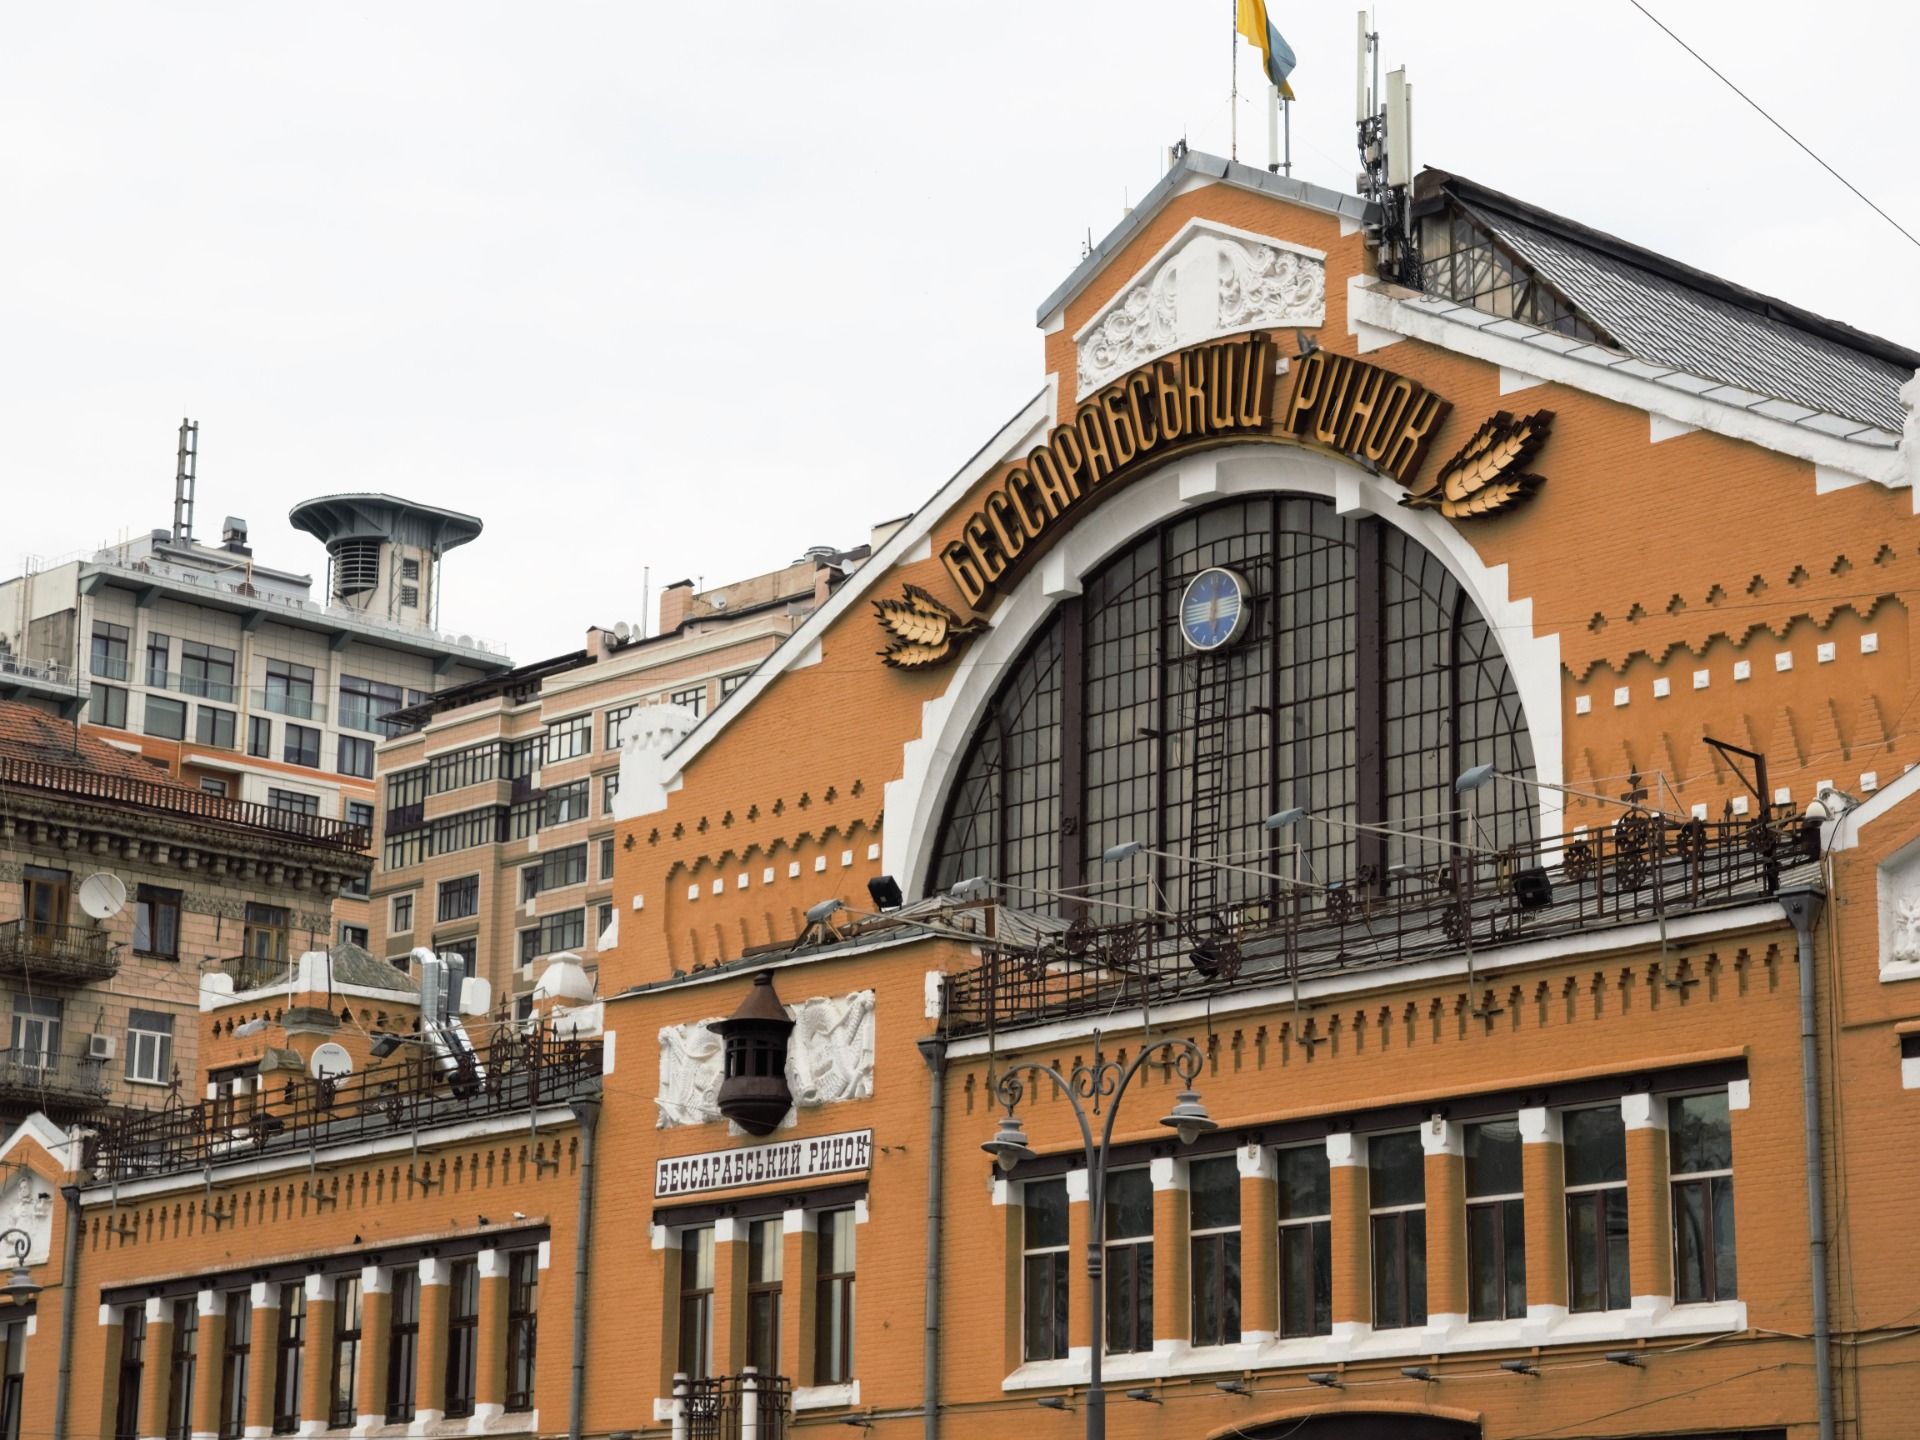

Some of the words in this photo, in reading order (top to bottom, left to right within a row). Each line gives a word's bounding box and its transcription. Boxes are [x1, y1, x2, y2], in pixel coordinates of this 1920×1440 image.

[938, 331, 1278, 608] БЕССАРАБСЬКИЙ
[1283, 350, 1454, 487] РИНОК
[659, 1143, 801, 1193] БЕССАРАБСЬКИЙ
[808, 1134, 869, 1172] РИНОК
